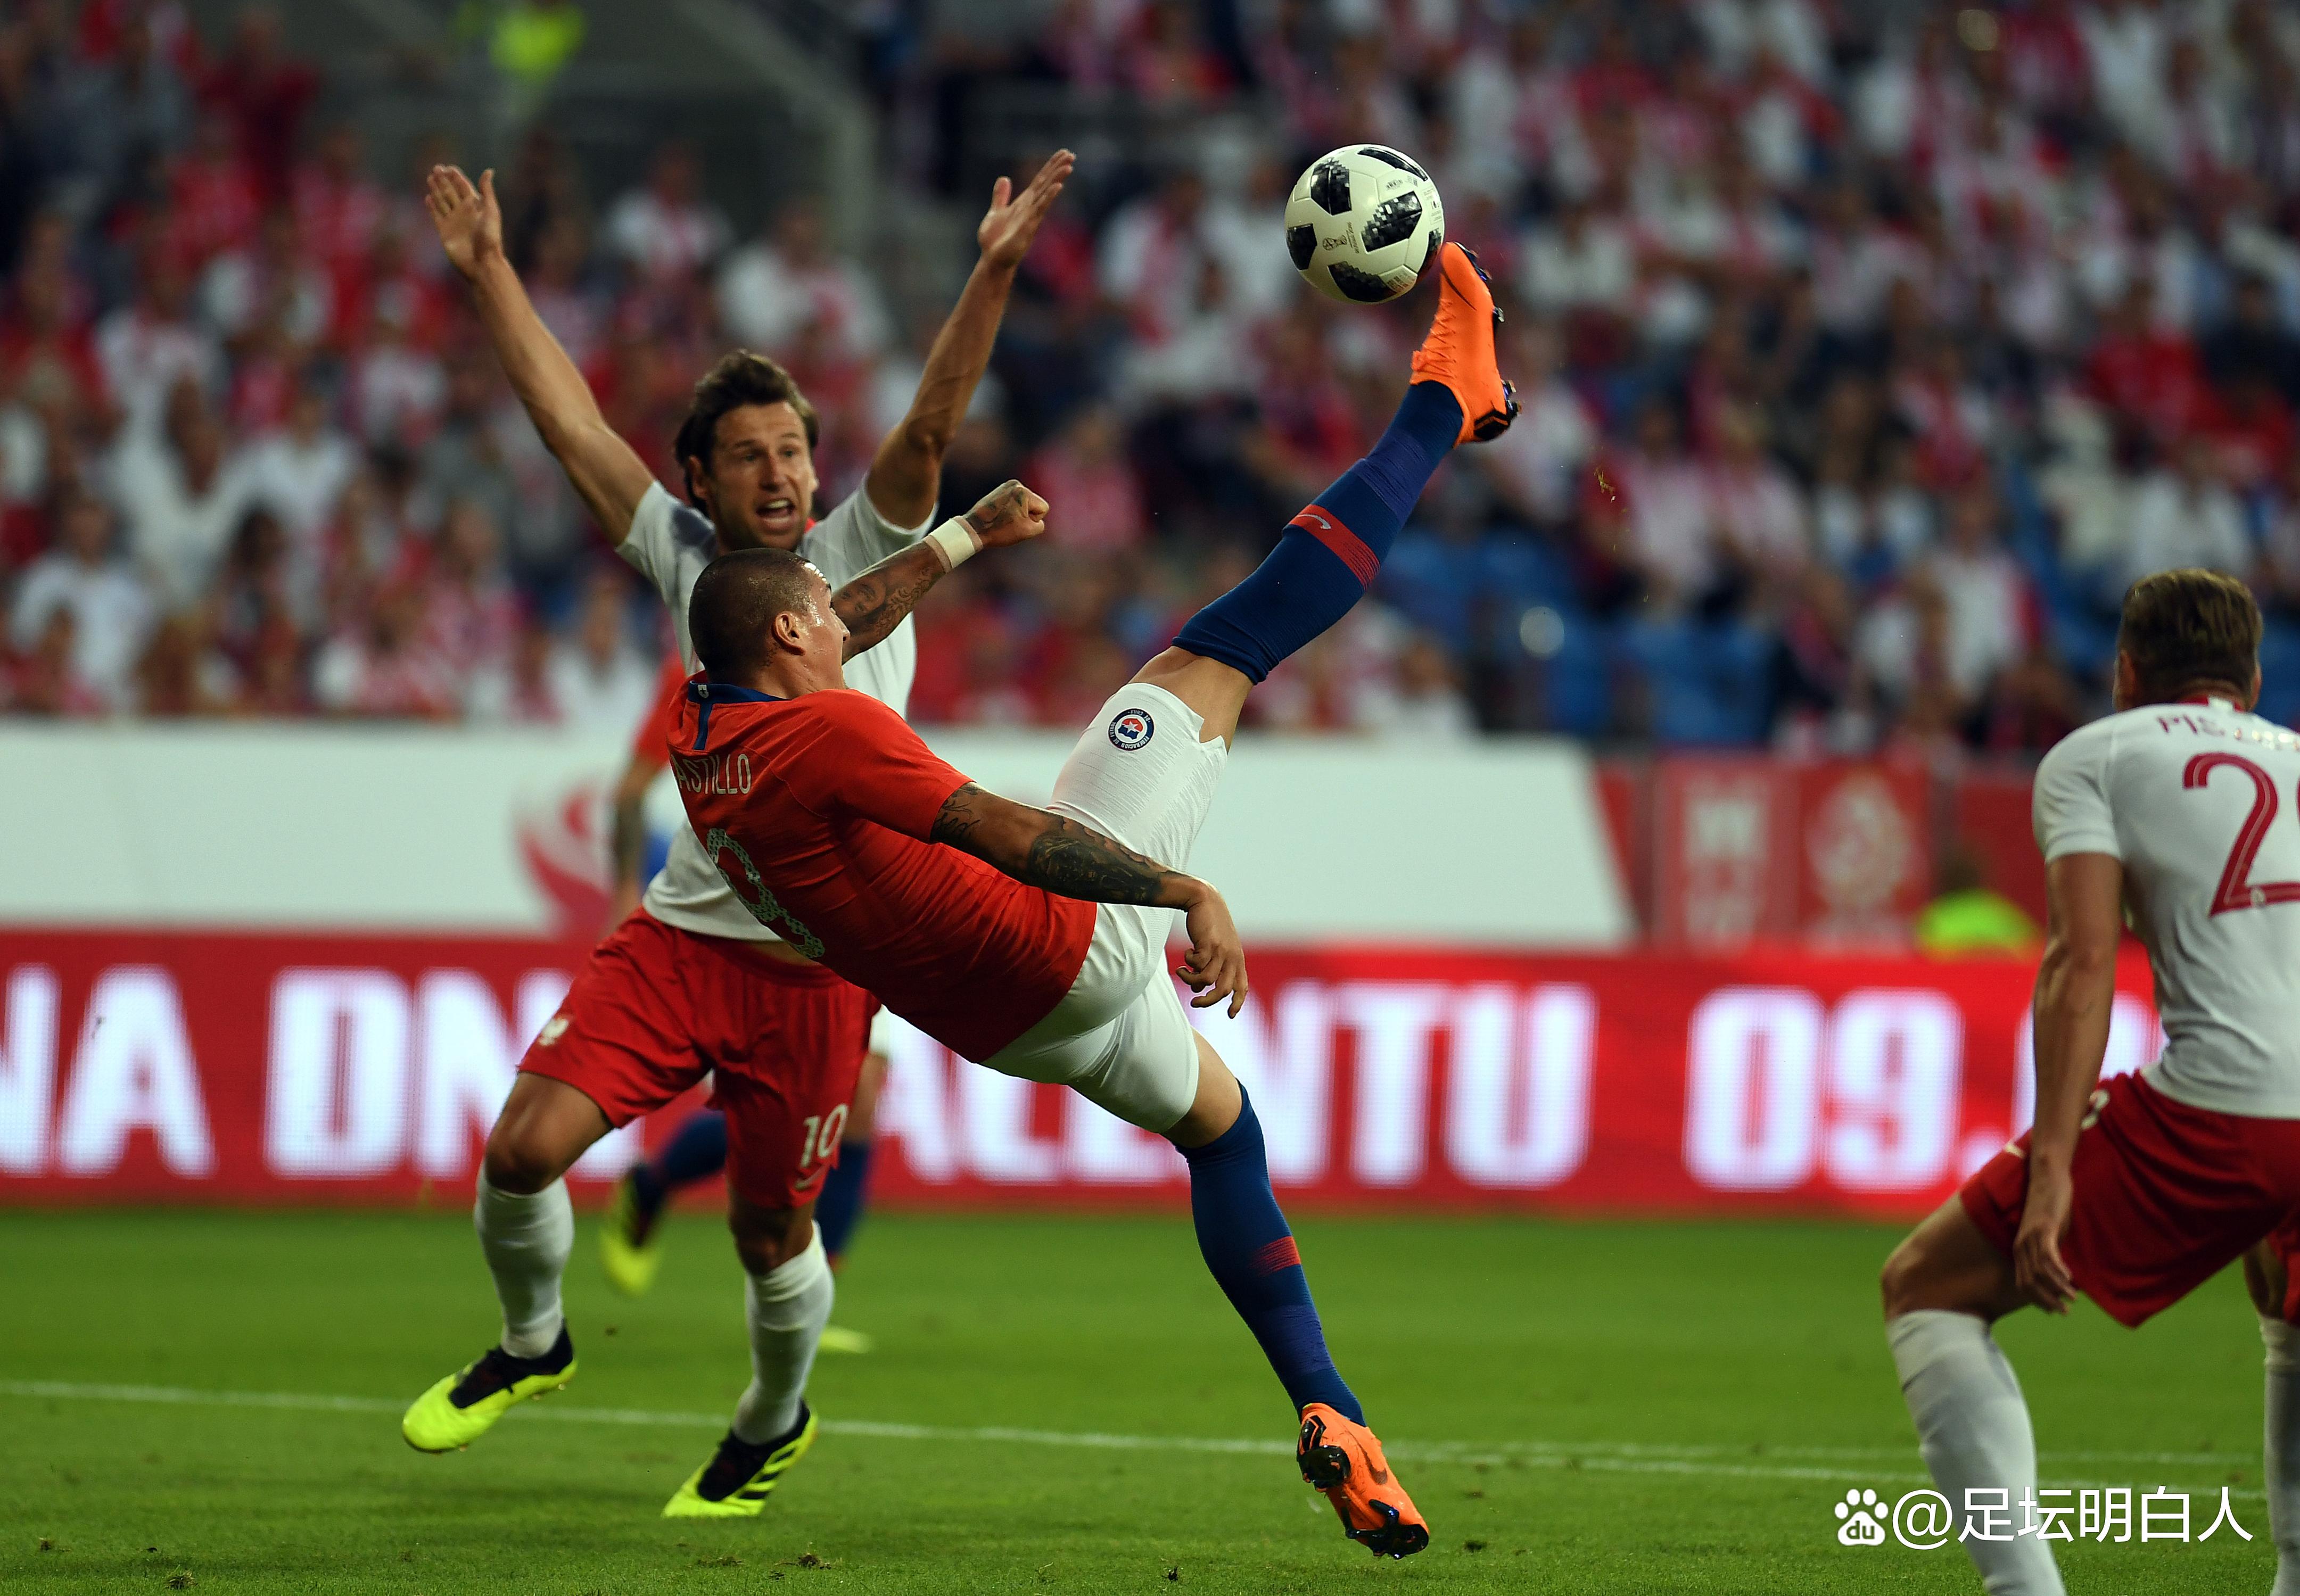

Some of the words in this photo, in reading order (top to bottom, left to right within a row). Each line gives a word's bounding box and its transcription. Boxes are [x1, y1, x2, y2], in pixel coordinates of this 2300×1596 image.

[670, 753, 751, 795] ASTILLO
[2183, 752, 2300, 917] 2
[801, 1103, 848, 1167] 10
